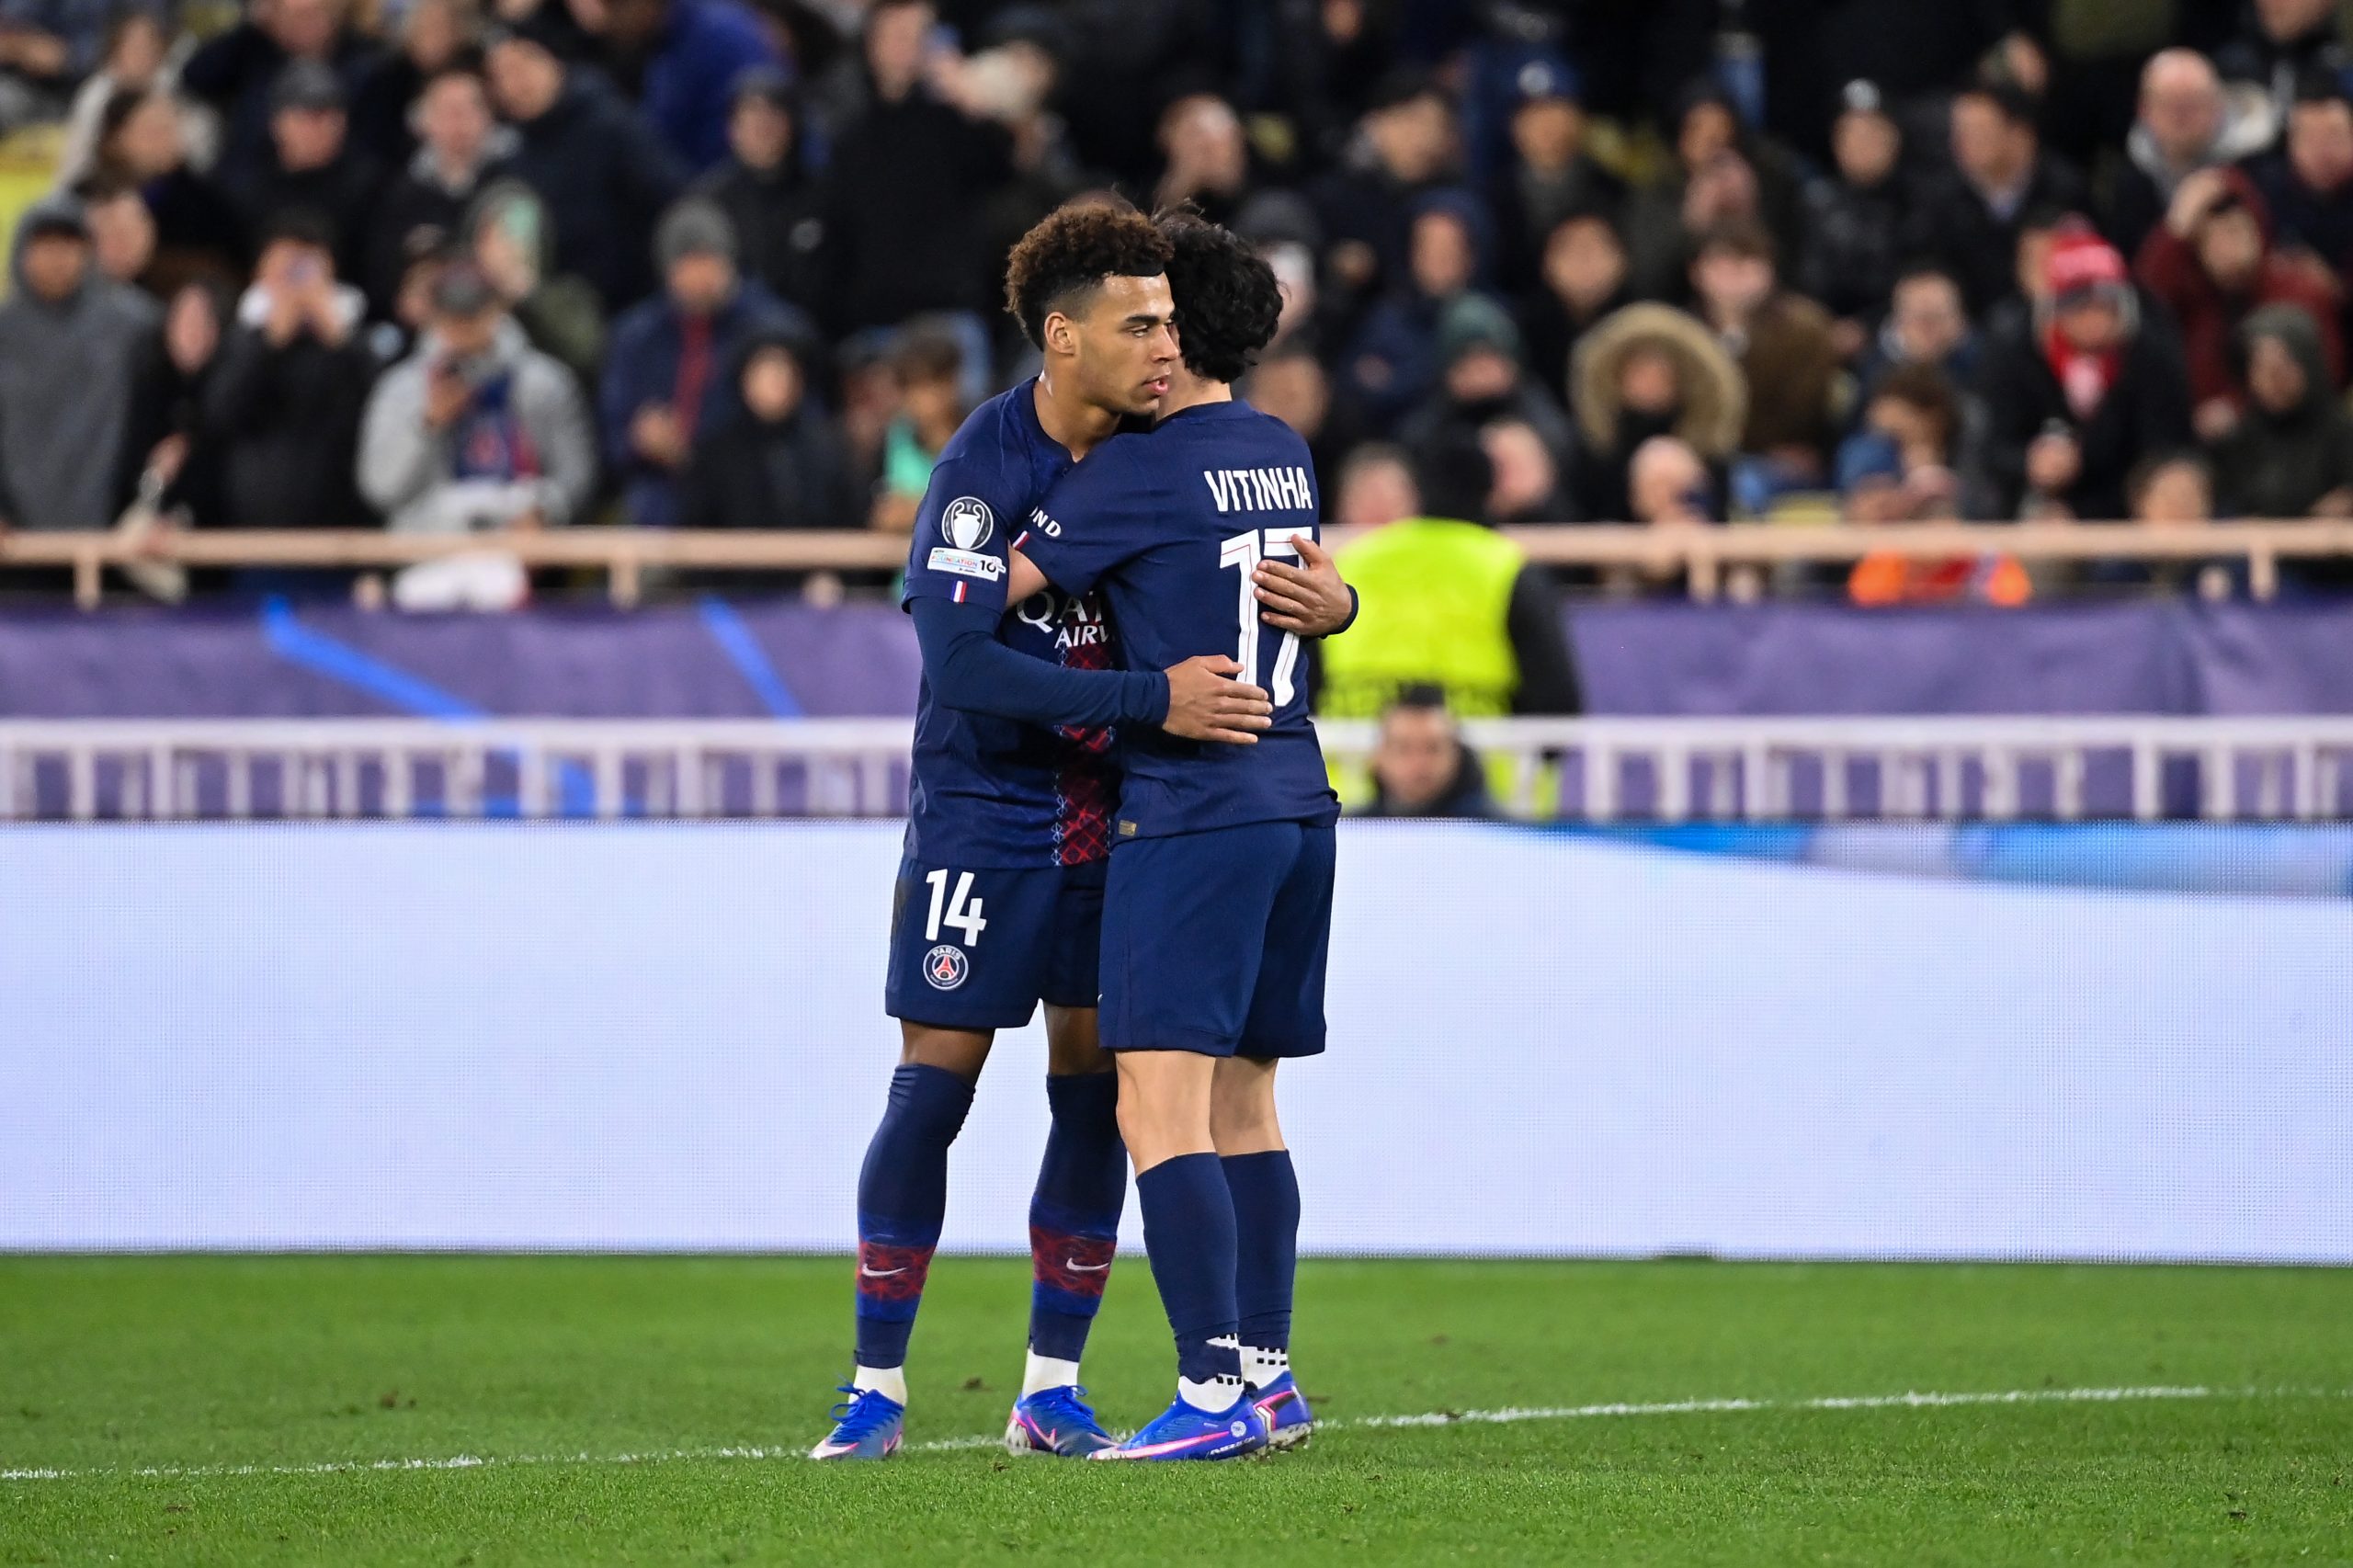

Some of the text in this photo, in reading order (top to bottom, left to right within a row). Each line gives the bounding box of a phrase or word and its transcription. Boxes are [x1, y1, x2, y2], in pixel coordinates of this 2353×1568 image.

[1204, 467, 1313, 512] VITINHA
[1029, 506, 1061, 538] ND
[1220, 527, 1313, 707] 17
[926, 869, 987, 947] 14
[932, 948, 961, 960] PARIS
